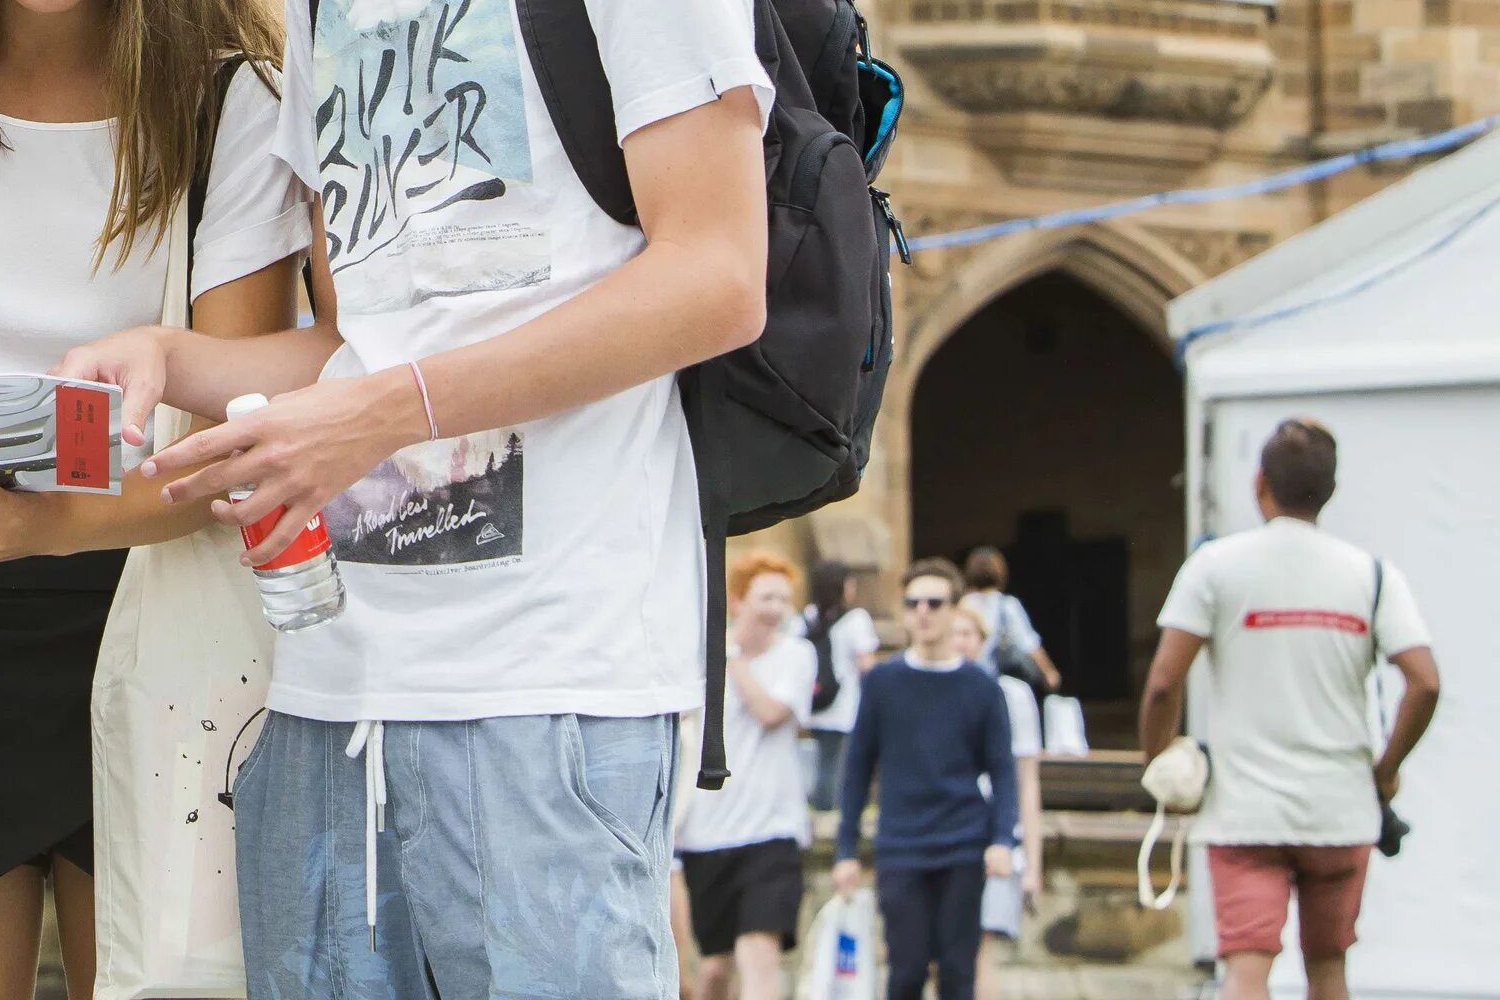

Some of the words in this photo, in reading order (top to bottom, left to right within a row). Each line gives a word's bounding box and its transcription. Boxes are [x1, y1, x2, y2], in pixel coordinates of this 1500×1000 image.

[364, 494, 397, 535] Road
[398, 490, 428, 522] Less
[385, 498, 487, 556] Travelled
